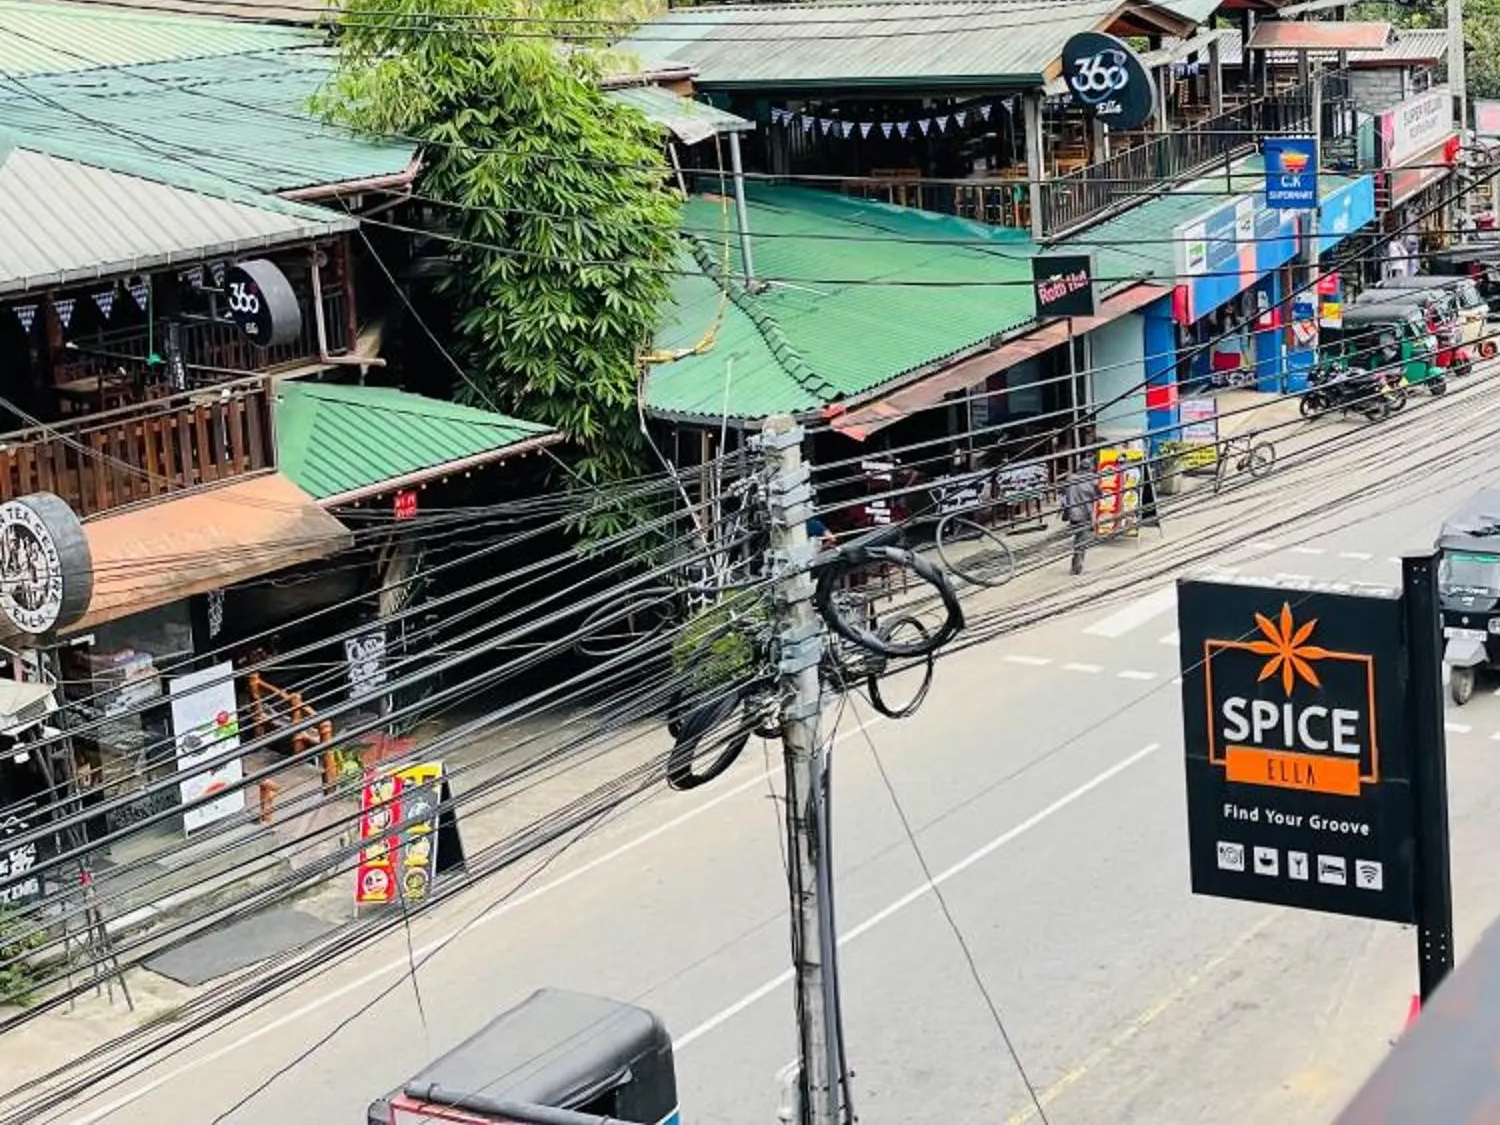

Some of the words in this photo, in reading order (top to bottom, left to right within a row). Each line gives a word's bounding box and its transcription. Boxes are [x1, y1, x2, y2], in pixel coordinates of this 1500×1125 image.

[229, 282, 259, 314] 360
[1222, 695, 1361, 755] SPICE
[1267, 757, 1319, 786] ELLA
[1265, 809, 1304, 828] Your
[1308, 814, 1371, 837] Groove
